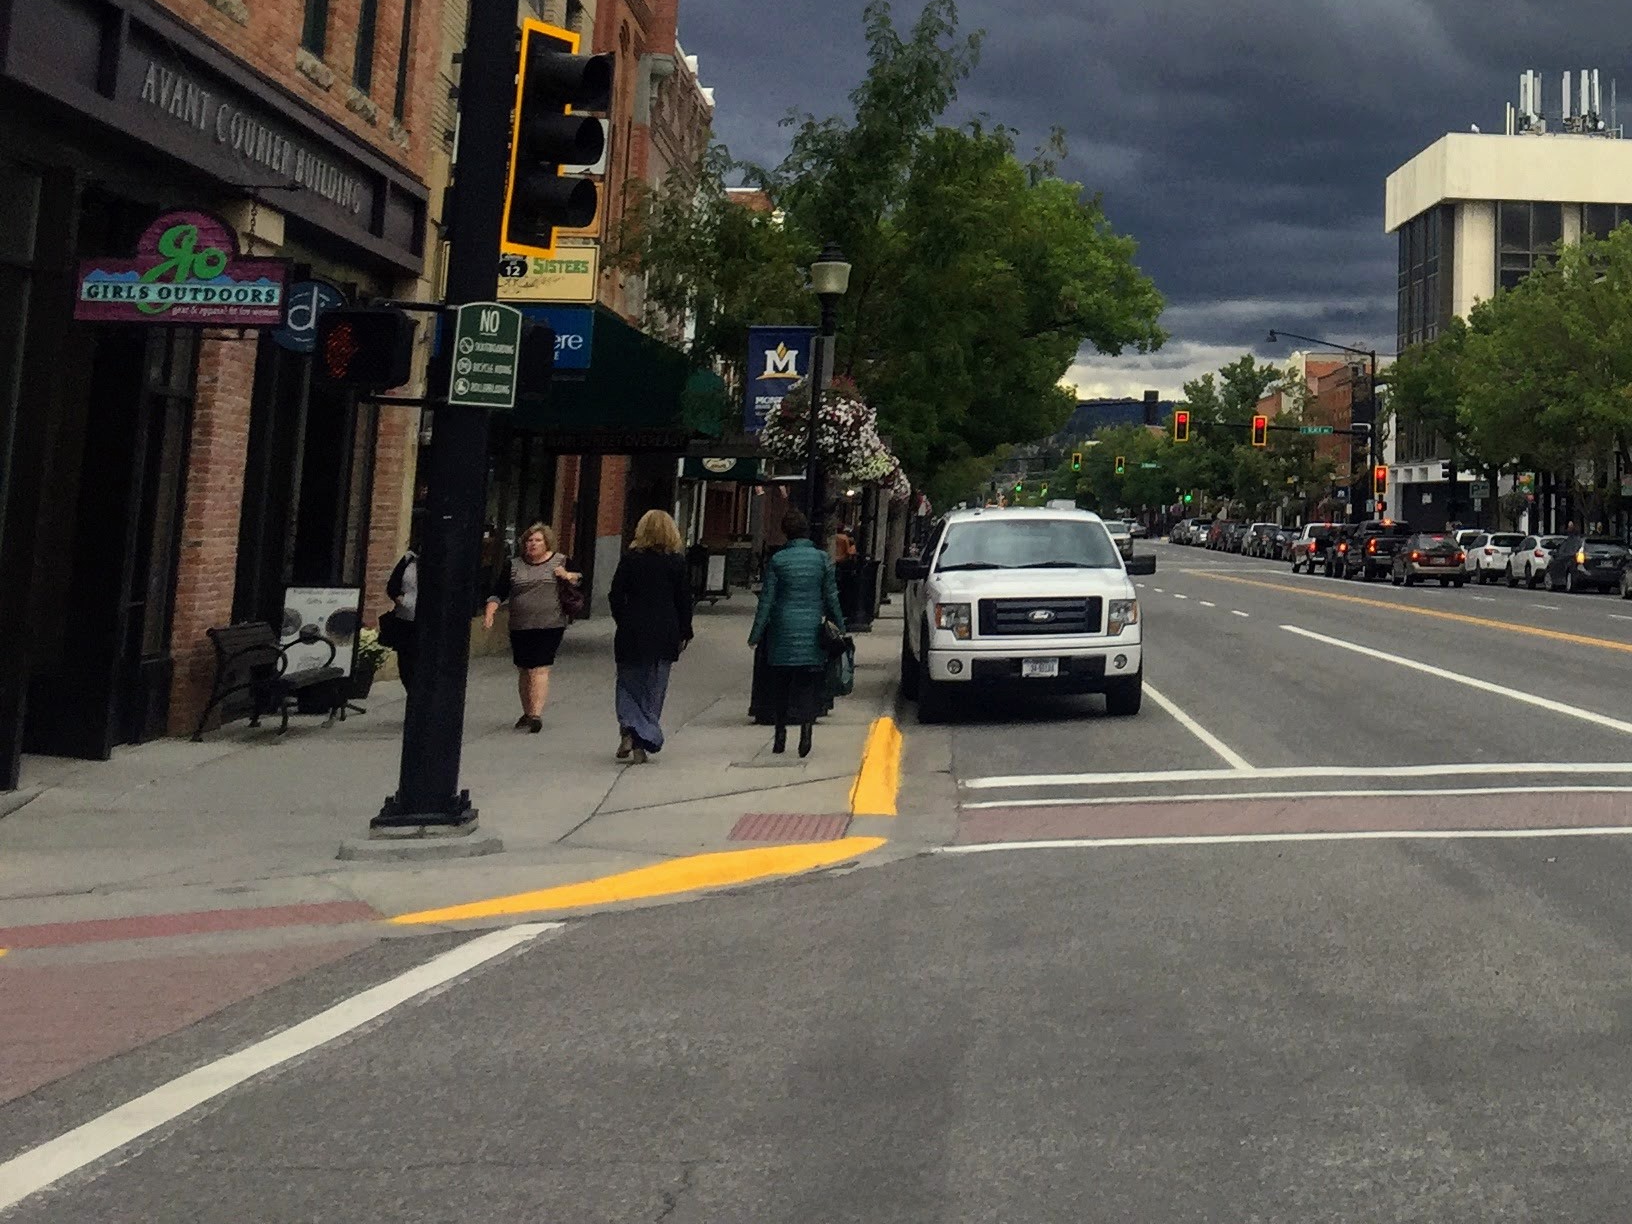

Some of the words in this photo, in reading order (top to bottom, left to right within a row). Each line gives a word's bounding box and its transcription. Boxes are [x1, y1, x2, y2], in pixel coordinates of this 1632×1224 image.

[141, 61, 210, 130] AVANT
[216, 103, 291, 175] COURIER
[294, 147, 361, 214] BUILDING
[136, 224, 229, 314] go
[504, 265, 521, 276] 12
[86, 284, 150, 300] GIRLS
[157, 286, 277, 304] OUTDOORS
[479, 309, 500, 333] NO
[764, 349, 799, 376] M
